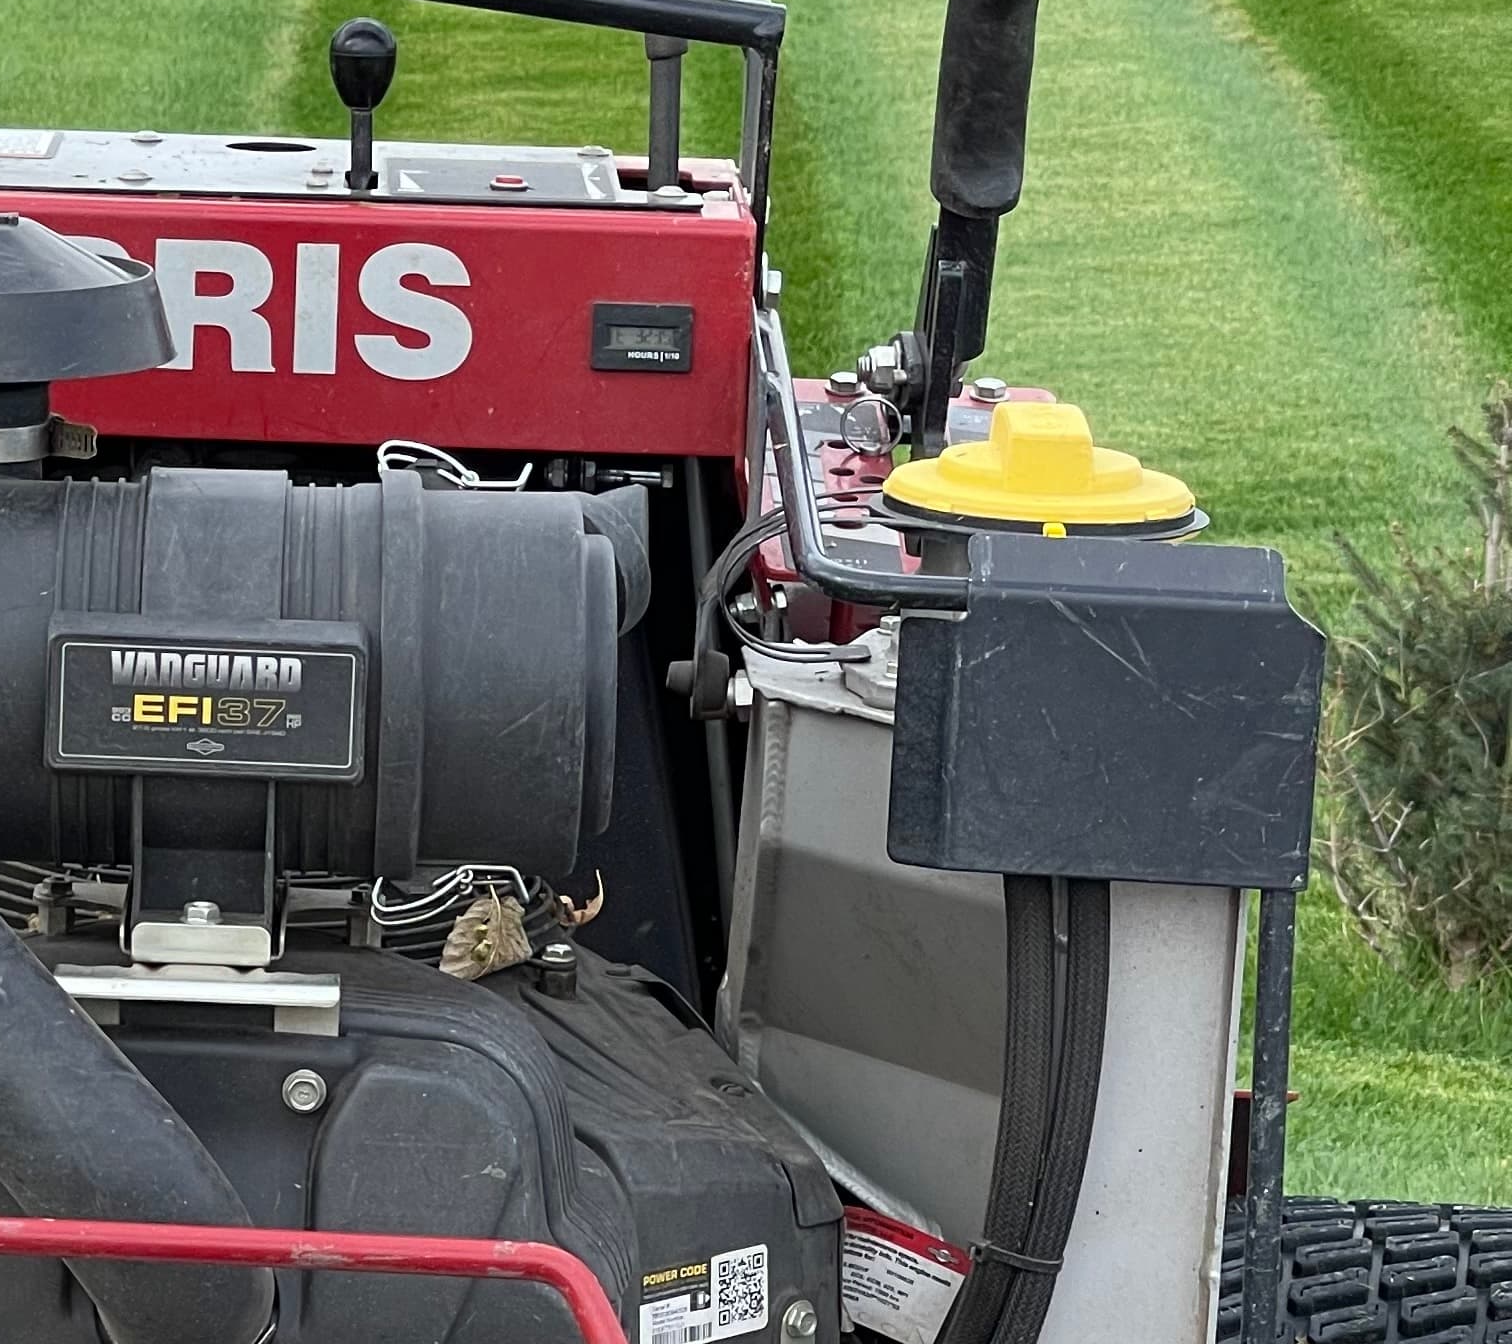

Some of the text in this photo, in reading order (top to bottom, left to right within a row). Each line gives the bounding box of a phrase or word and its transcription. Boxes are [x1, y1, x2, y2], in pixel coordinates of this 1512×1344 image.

[627, 351, 659, 360] HOURS
[111, 651, 302, 692] VANGUARD
[643, 1263, 708, 1287] POWER CODE
